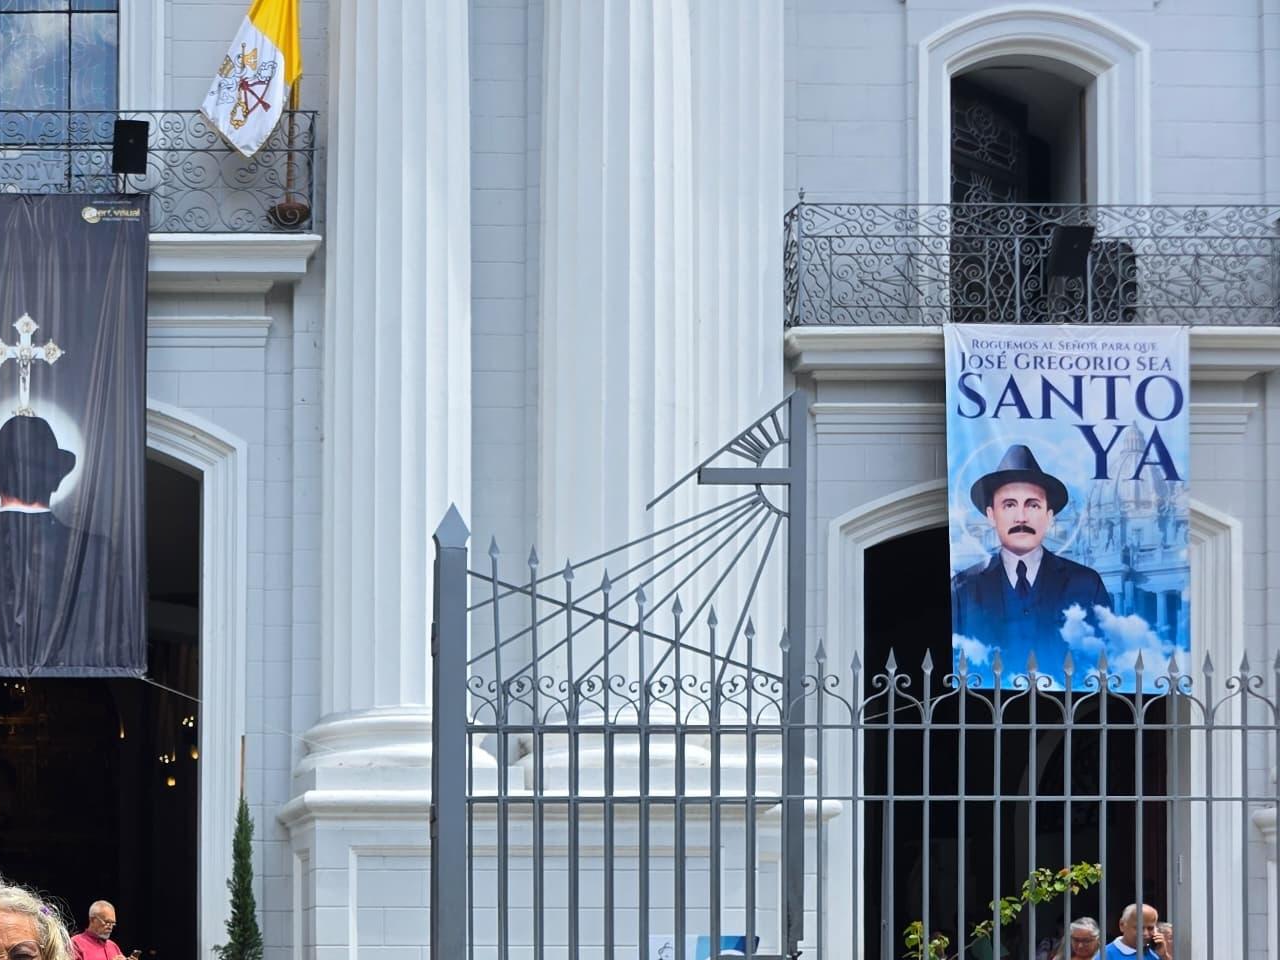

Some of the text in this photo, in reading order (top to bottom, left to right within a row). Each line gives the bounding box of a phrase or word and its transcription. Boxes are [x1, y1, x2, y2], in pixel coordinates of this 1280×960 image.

[960, 350, 1172, 373] JOSÉ GREGORIO SEA
[971, 339, 1157, 354] ROGUEMOS AL SEÑOR PARA QUE
[957, 372, 1184, 422] SANTO
[1072, 423, 1185, 482] YA
